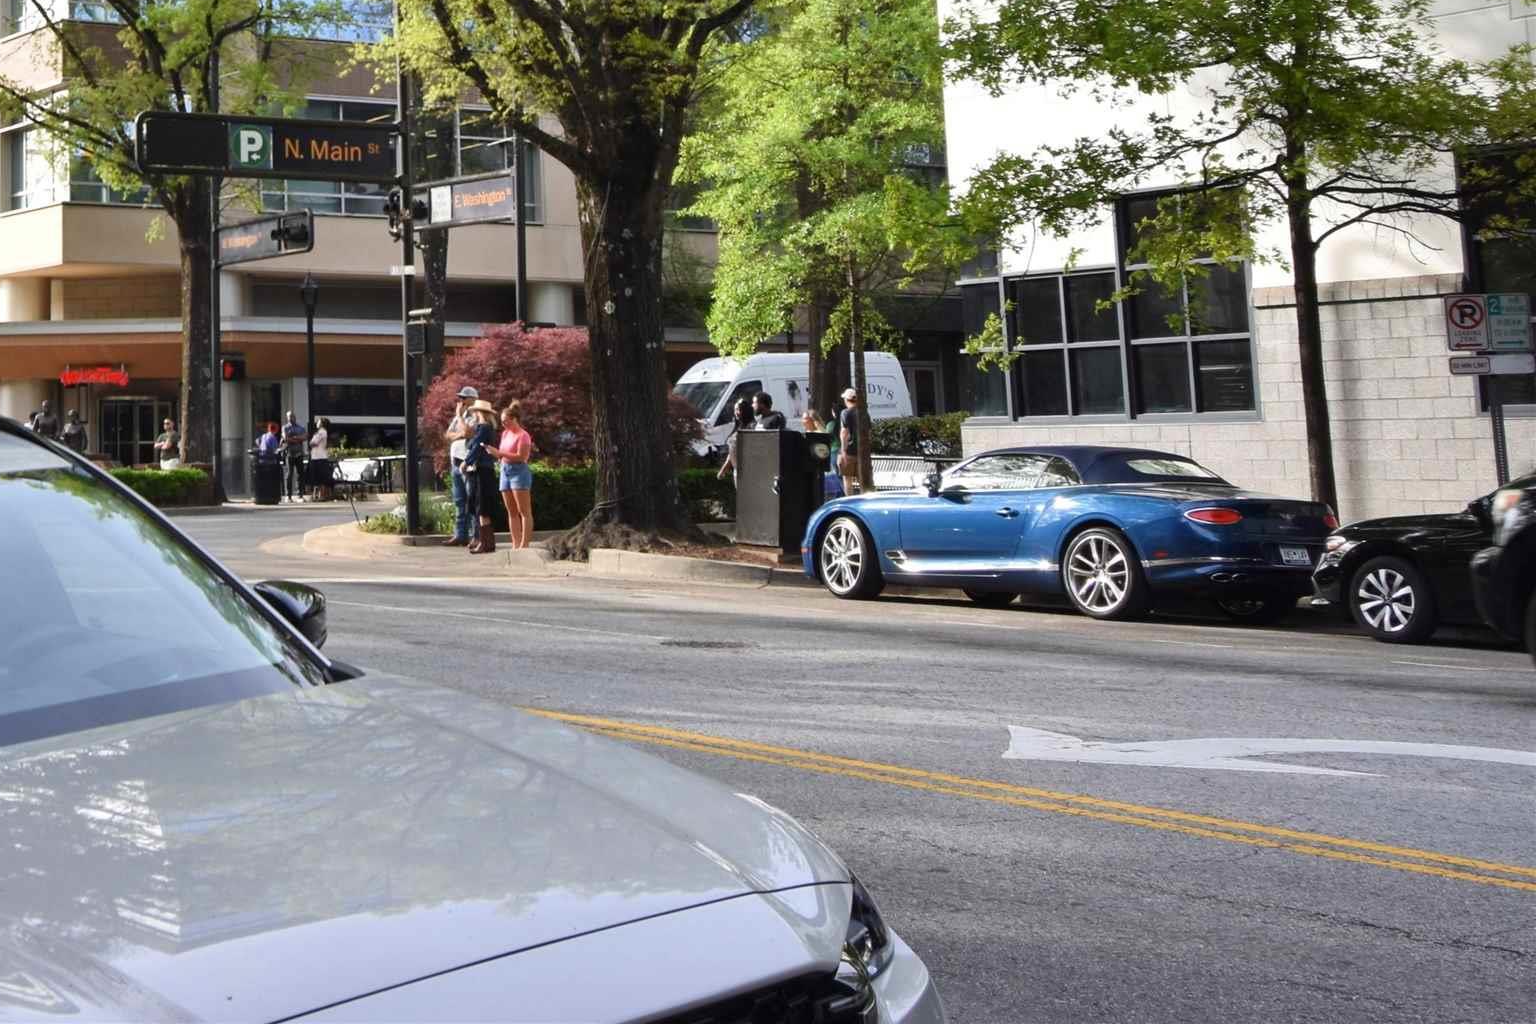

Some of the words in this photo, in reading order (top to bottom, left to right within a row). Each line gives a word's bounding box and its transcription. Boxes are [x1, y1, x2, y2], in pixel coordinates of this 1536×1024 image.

[240, 130, 263, 163] P
[284, 138, 304, 159] N.
[311, 139, 362, 162] Main
[368, 143, 381, 155] St
